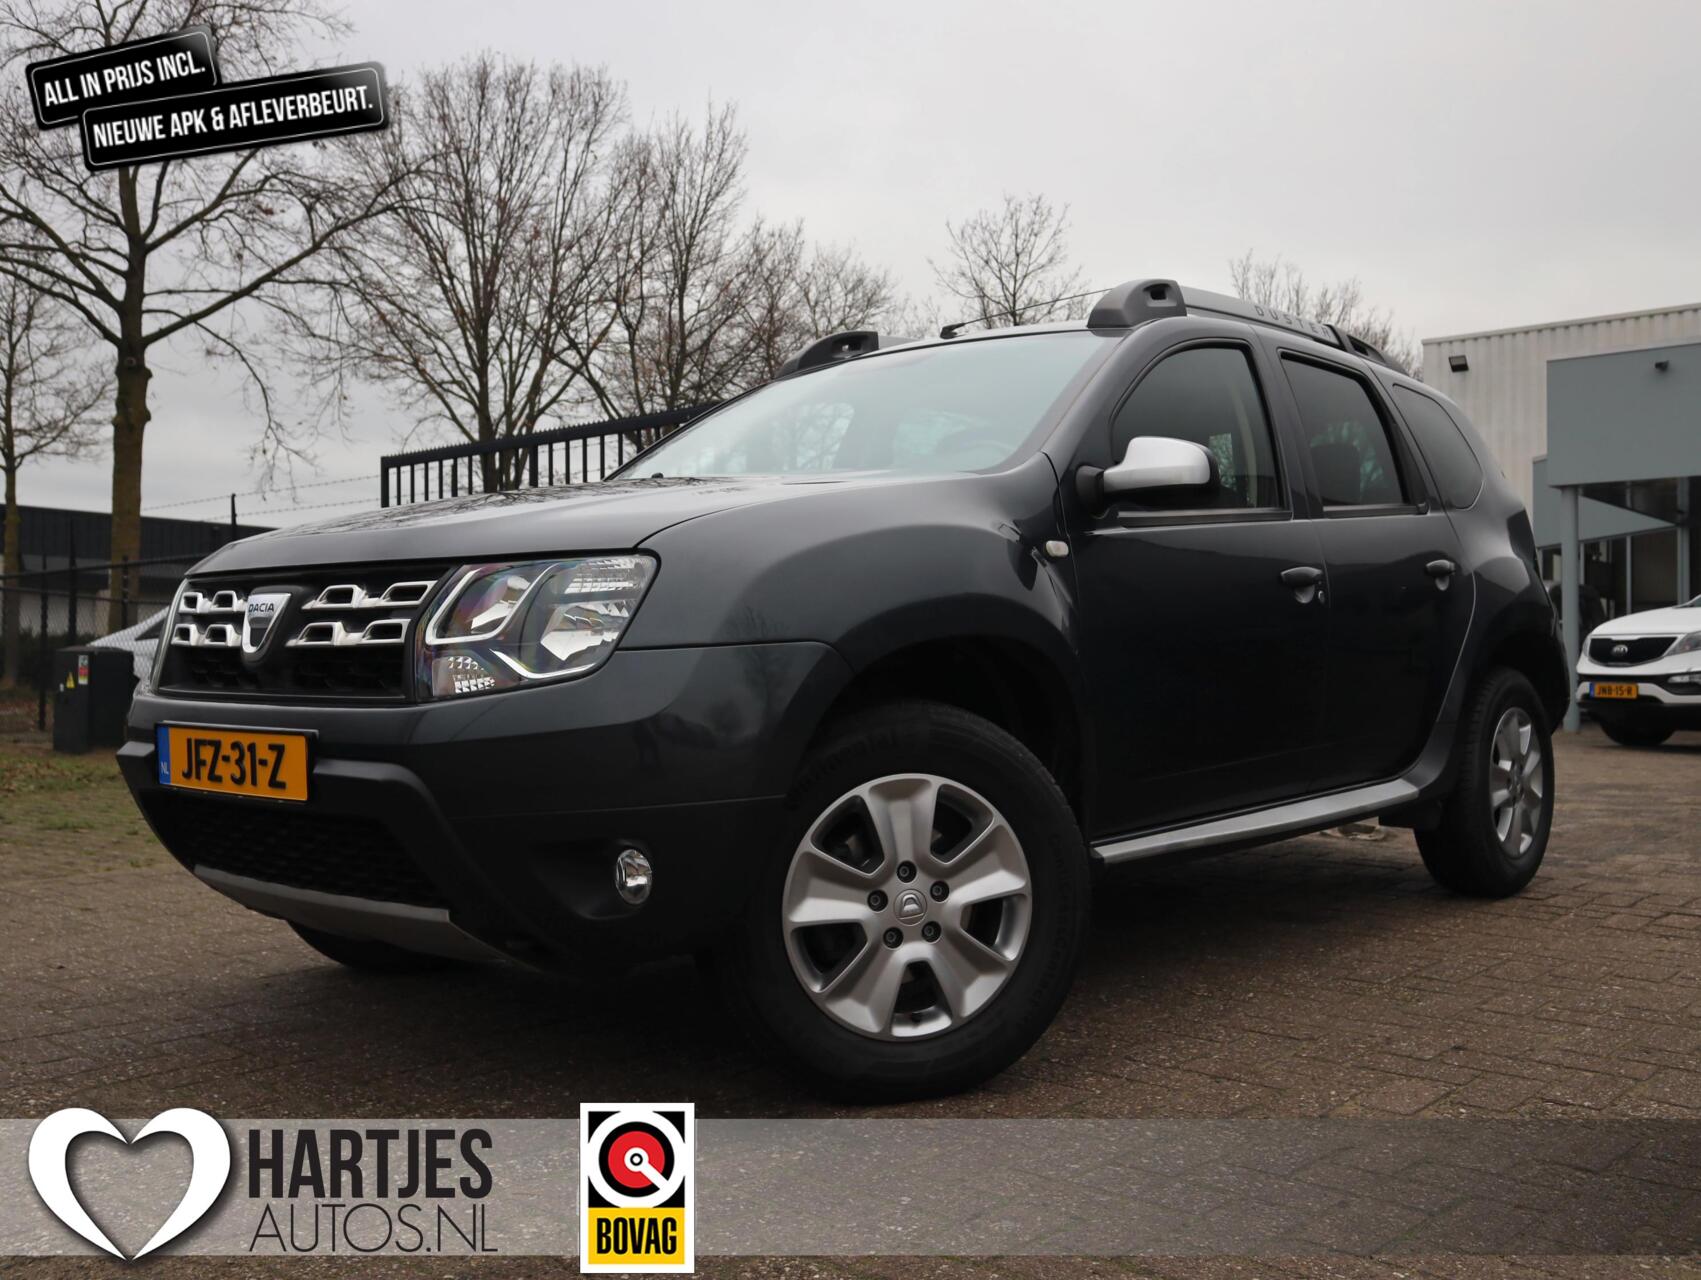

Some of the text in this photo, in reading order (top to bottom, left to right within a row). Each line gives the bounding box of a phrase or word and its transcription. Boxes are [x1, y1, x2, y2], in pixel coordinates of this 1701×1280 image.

[248, 602, 275, 613] DACIA
[160, 761, 170, 776] NL
[182, 738, 287, 790] JFZ-31-Z
